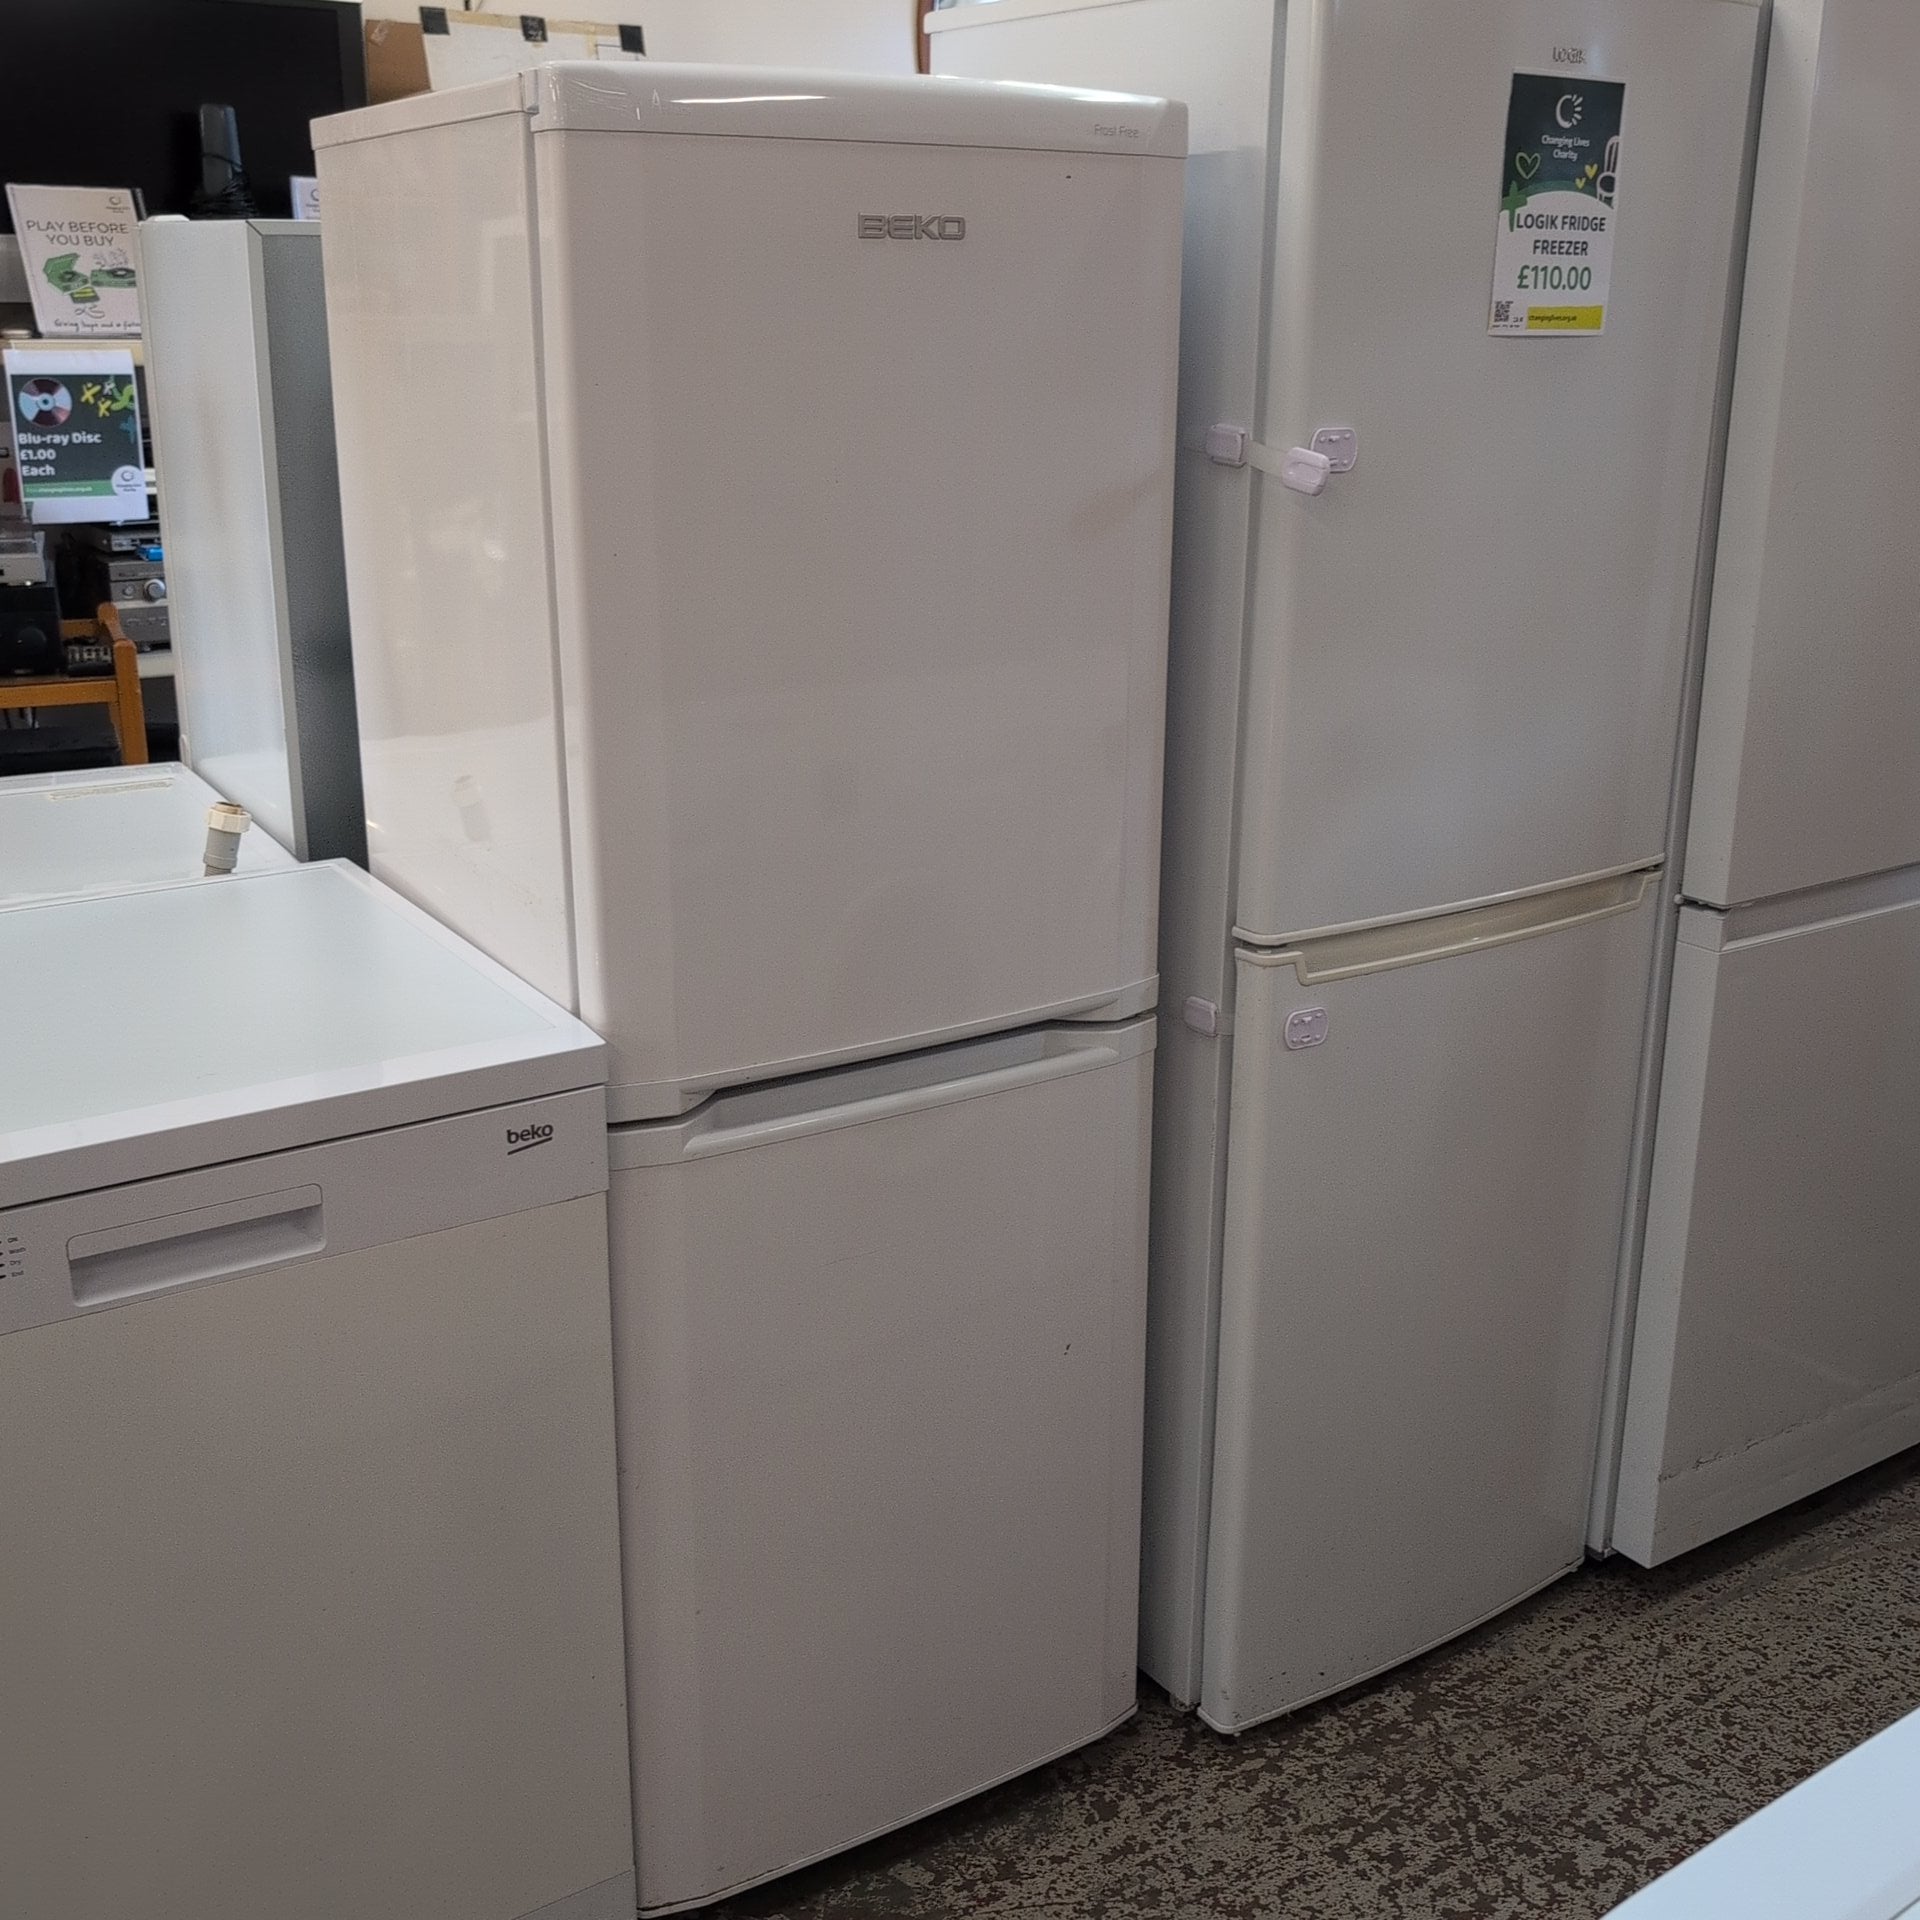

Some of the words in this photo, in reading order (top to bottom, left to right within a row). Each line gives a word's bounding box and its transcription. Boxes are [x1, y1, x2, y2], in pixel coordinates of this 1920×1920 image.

[1541, 134, 1573, 148] Changing
[1573, 136, 1590, 147] Lives
[1553, 149, 1578, 162] Charity
[26, 220, 65, 232] PLAY
[68, 222, 129, 234] BEFORE
[857, 213, 966, 240] BEKO
[1516, 213, 1559, 231] LOGIK
[1561, 215, 1606, 232] FRIDGE
[46, 234, 80, 246] YOU
[83, 235, 114, 246] BUY
[1532, 239, 1589, 256] FREEZER
[1517, 264, 1592, 291] £110.00
[18, 433, 69, 446] Blu-ray
[72, 431, 102, 444] Disc
[20, 449, 56, 460] £1.00
[22, 464, 56, 476] Each
[506, 1124, 554, 1144] beko
